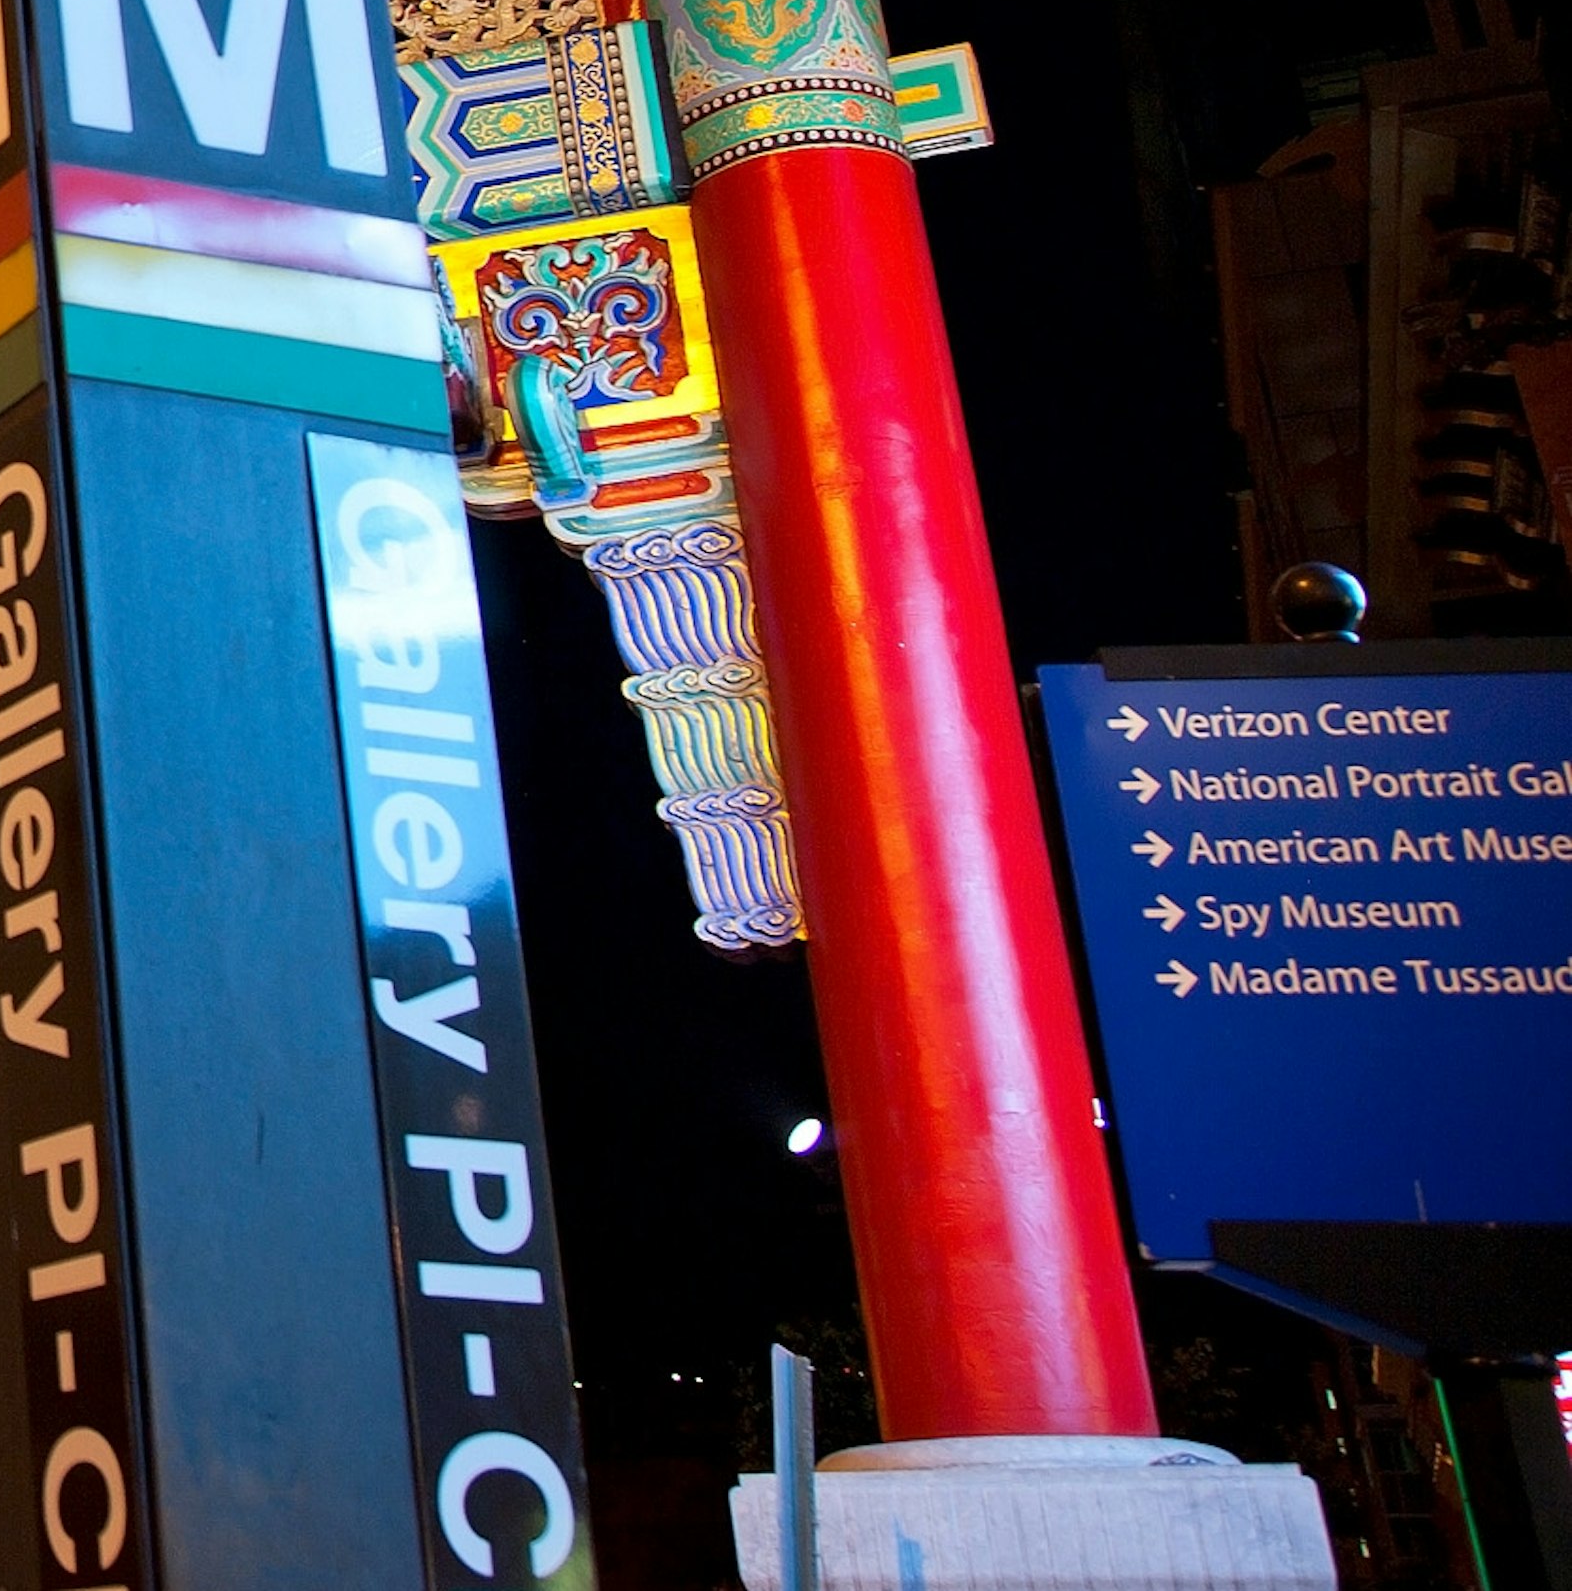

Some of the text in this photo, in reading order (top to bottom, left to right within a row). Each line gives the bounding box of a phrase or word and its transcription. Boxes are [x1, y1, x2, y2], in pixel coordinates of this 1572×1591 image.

[1157, 703, 1450, 739] Verizon Center
[336, 477, 489, 1075] Gallery
[1169, 765, 1339, 802] National
[1346, 762, 1501, 800] Portrait
[1187, 829, 1380, 865] American
[1390, 828, 1456, 863] Art
[1195, 894, 1461, 937] Spy Museum
[1208, 958, 1397, 995] Madame
[19, 1123, 128, 1591] Pl-C
